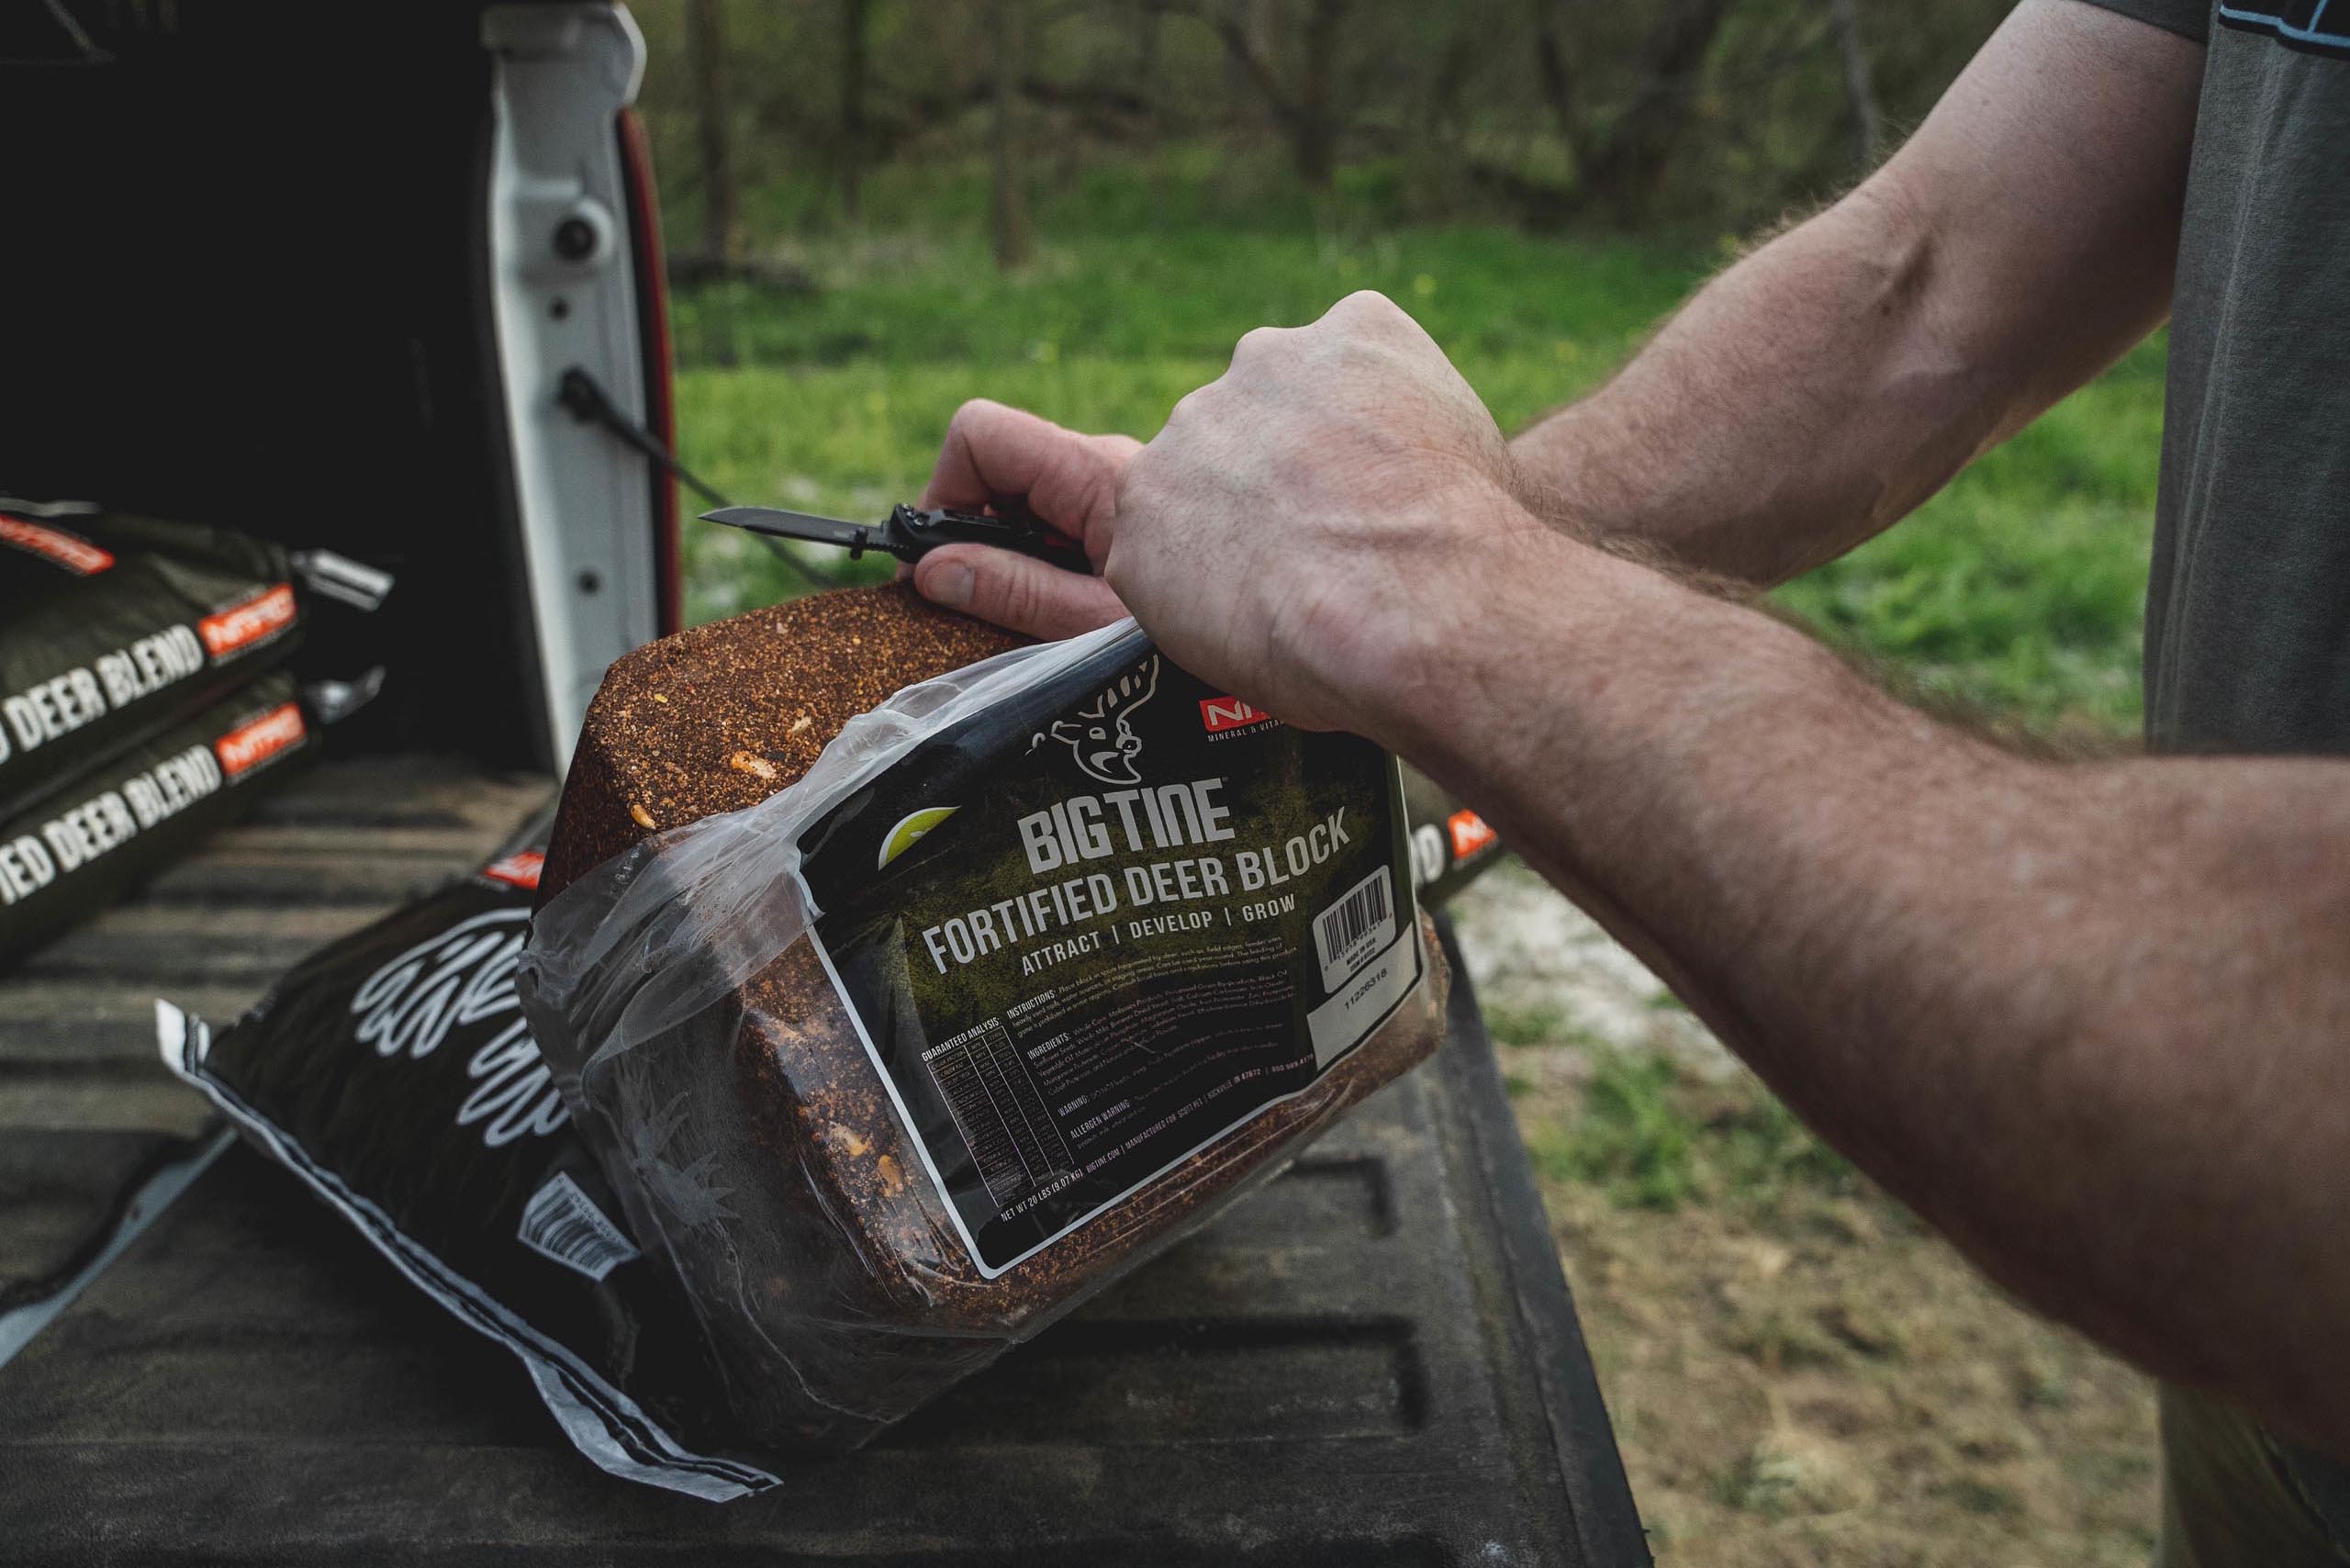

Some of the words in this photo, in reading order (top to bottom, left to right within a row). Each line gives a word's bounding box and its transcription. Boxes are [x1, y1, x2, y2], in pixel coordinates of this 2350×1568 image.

[4, 667, 107, 752] DEER
[96, 624, 205, 709] BLEND
[1207, 729, 1248, 742] MINERAL
[43, 791, 138, 873] DEER
[124, 745, 221, 827] BLEND
[1017, 778, 1236, 875] BIGTINE
[923, 874, 1117, 975] FORTIFIED
[1124, 857, 1230, 907] DEER
[1236, 806, 1350, 891] BLOCK
[1022, 931, 1100, 977] ATTRACT
[1129, 911, 1213, 939] DEVELOP
[1242, 893, 1295, 923] GROW
[1007, 990, 1058, 1020] INSTRUCTIONS:
[921, 1032, 967, 1062] GUARANTEED
[968, 1016, 1001, 1039] ANALYSIS:
[1027, 1032, 1071, 1059] INGREDIENTS:
[1058, 1094, 1091, 1116] WARNING:
[1070, 1115, 1102, 1139] ALLERGEN
[1001, 1207, 1016, 1222] NET
[1016, 1201, 1028, 1213] WT
[1027, 1196, 1038, 1206] 20
[1038, 1186, 1052, 1202] LBS
